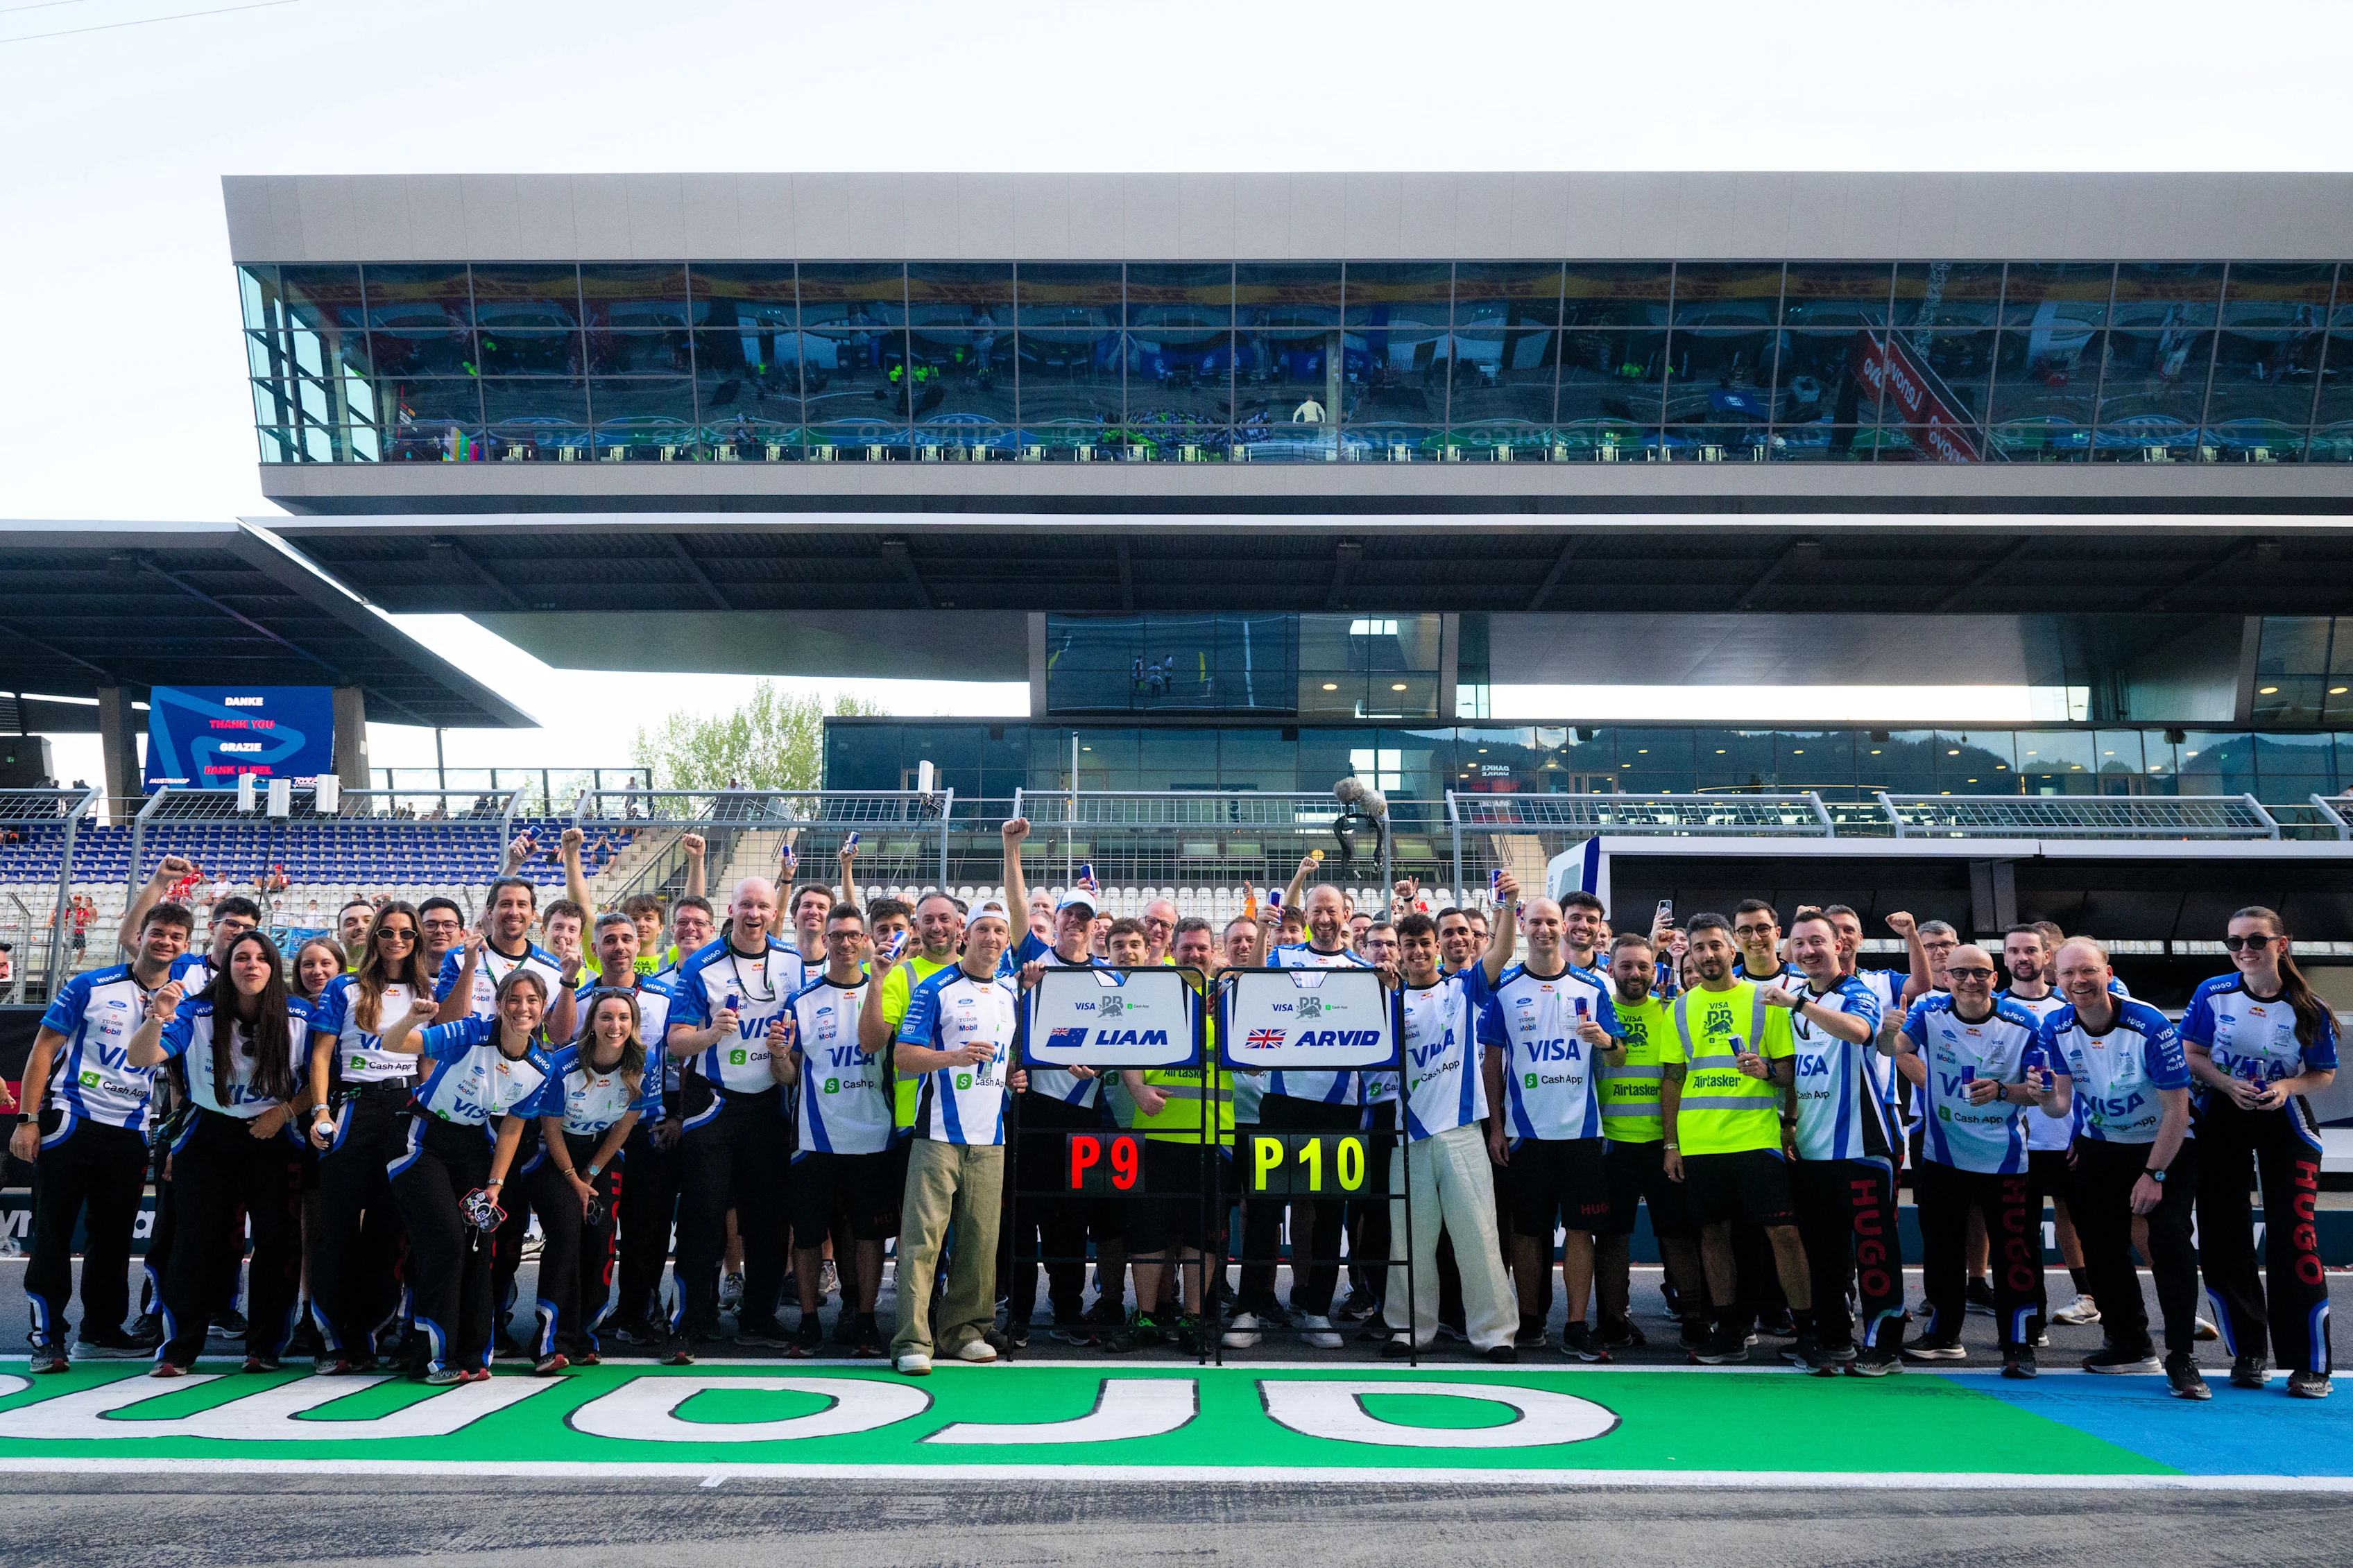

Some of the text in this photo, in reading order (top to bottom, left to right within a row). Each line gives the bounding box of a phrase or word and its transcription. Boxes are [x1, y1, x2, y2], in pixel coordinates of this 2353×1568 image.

[225, 697, 264, 706] DANKE
[209, 720, 275, 729] THANK YOU
[219, 743, 262, 752] GRAZIE
[204, 766, 235, 775] DANK
[249, 766, 273, 775] WEL
[776, 942, 796, 951] HUGO
[538, 954, 559, 967] HUGO
[701, 949, 721, 964] HUGO
[1351, 955, 1371, 965] HUGO
[96, 973, 121, 983] HUGO
[937, 974, 954, 986] HUGO
[1575, 971, 1596, 982] HUGO
[646, 983, 667, 992] HUGO
[796, 982, 816, 995] HUGO
[2209, 981, 2232, 992] HUGO
[1854, 993, 1876, 1003] VISA
[288, 1006, 307, 1017] UGO
[2003, 1010, 2025, 1022] HUGO
[738, 1016, 778, 1040] VIS
[2127, 1016, 2146, 1029] HUGO
[100, 1026, 121, 1036] Mobil
[2156, 1027, 2175, 1040] VISA
[1095, 1030, 1167, 1045] LIAM
[1294, 1031, 1380, 1046] ARVID
[751, 1051, 772, 1061] Cash
[1522, 1039, 1581, 1062] VISA
[533, 1053, 551, 1070] HUGO
[1936, 1054, 1956, 1065] Mobil
[369, 1062, 412, 1071] Cash App
[666, 1065, 680, 1073] Cas
[1421, 1060, 1460, 1082] Cash App
[844, 1079, 866, 1089] Cash
[975, 1077, 994, 1087] Cash
[1541, 1073, 1582, 1084] Cash App
[1693, 1075, 1740, 1088] Airtasker
[103, 1081, 147, 1099] Cash App
[457, 1084, 474, 1096] Mobil
[463, 1079, 479, 1090] TUDOR
[1614, 1084, 1660, 1096] Airtasker
[565, 1110, 582, 1119] Mobil
[1954, 1112, 2003, 1124] Cash App
[570, 1121, 608, 1132] VIS
[1254, 1136, 1365, 1191] P10
[2293, 1160, 2323, 1285] HUGO
[1850, 1179, 1891, 1297] HUGO
[2002, 1179, 2035, 1292] HUGO
